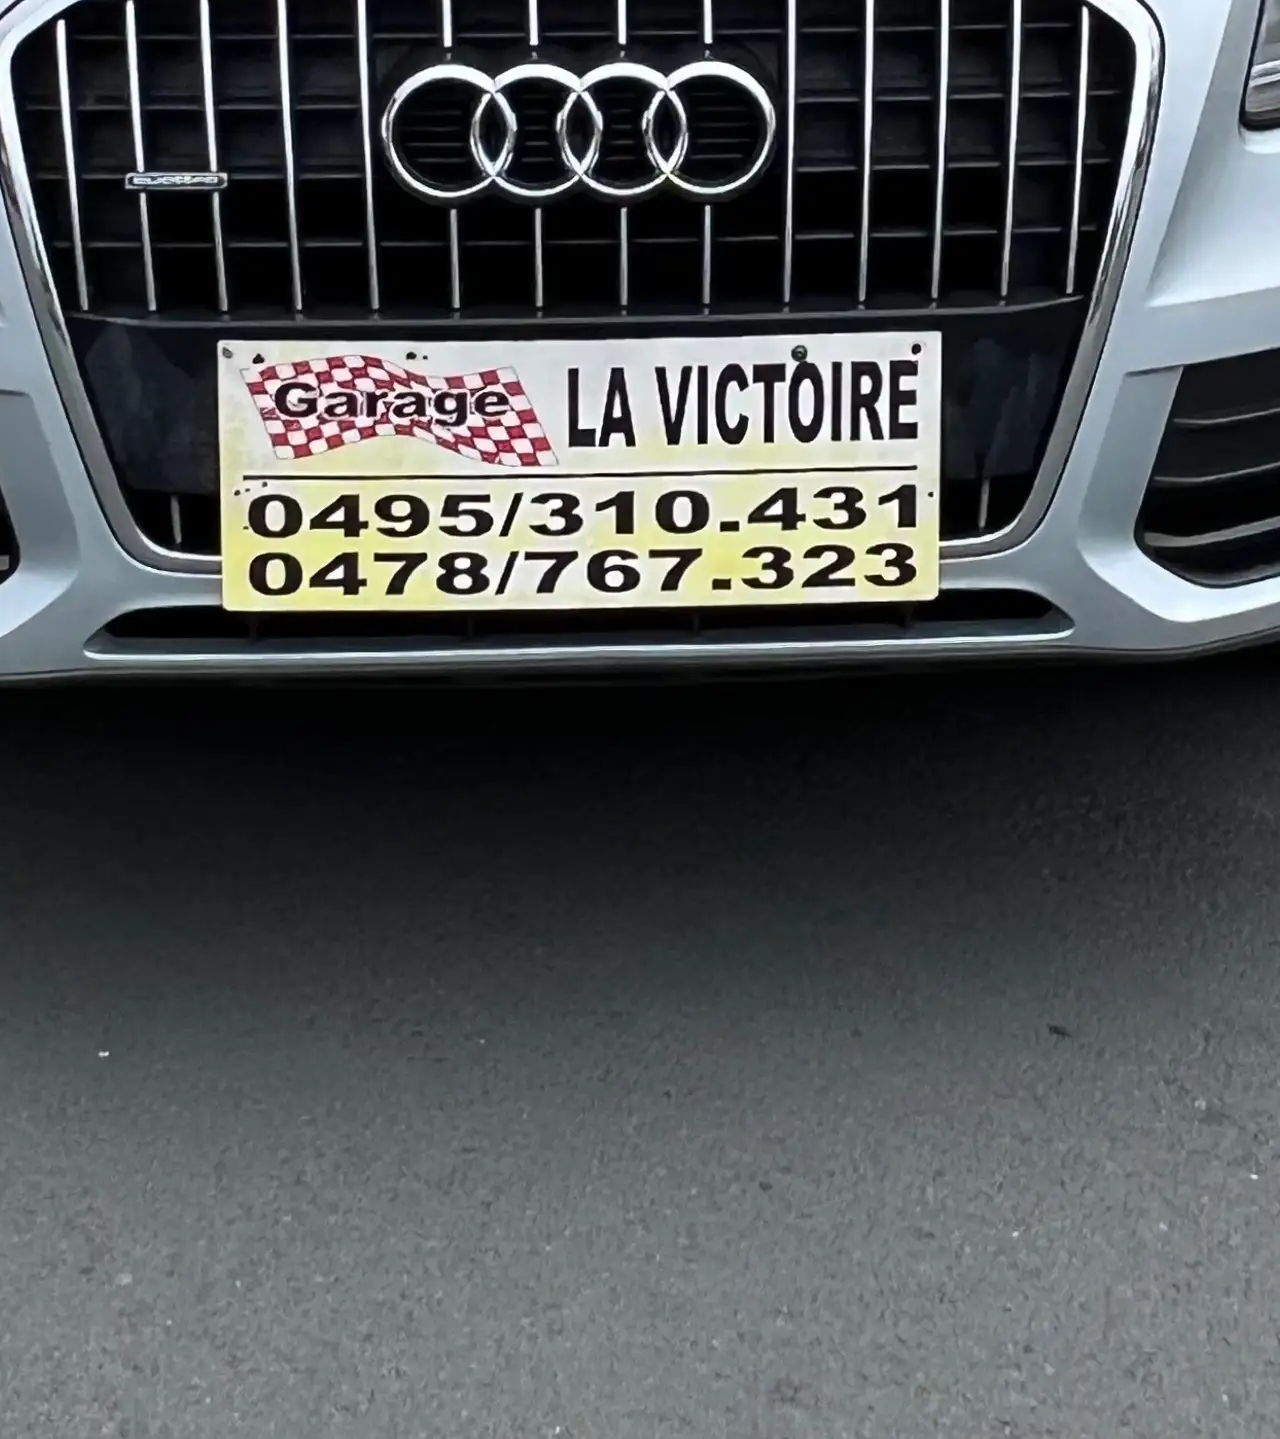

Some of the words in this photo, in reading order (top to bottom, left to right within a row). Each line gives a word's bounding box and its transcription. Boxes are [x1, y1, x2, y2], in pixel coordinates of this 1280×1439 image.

[273, 381, 511, 428] Garage
[567, 366, 637, 448] LA
[654, 359, 919, 446] VICTOIRE
[247, 483, 917, 539] 0495/310.431
[248, 542, 918, 596] 0478/767.323
